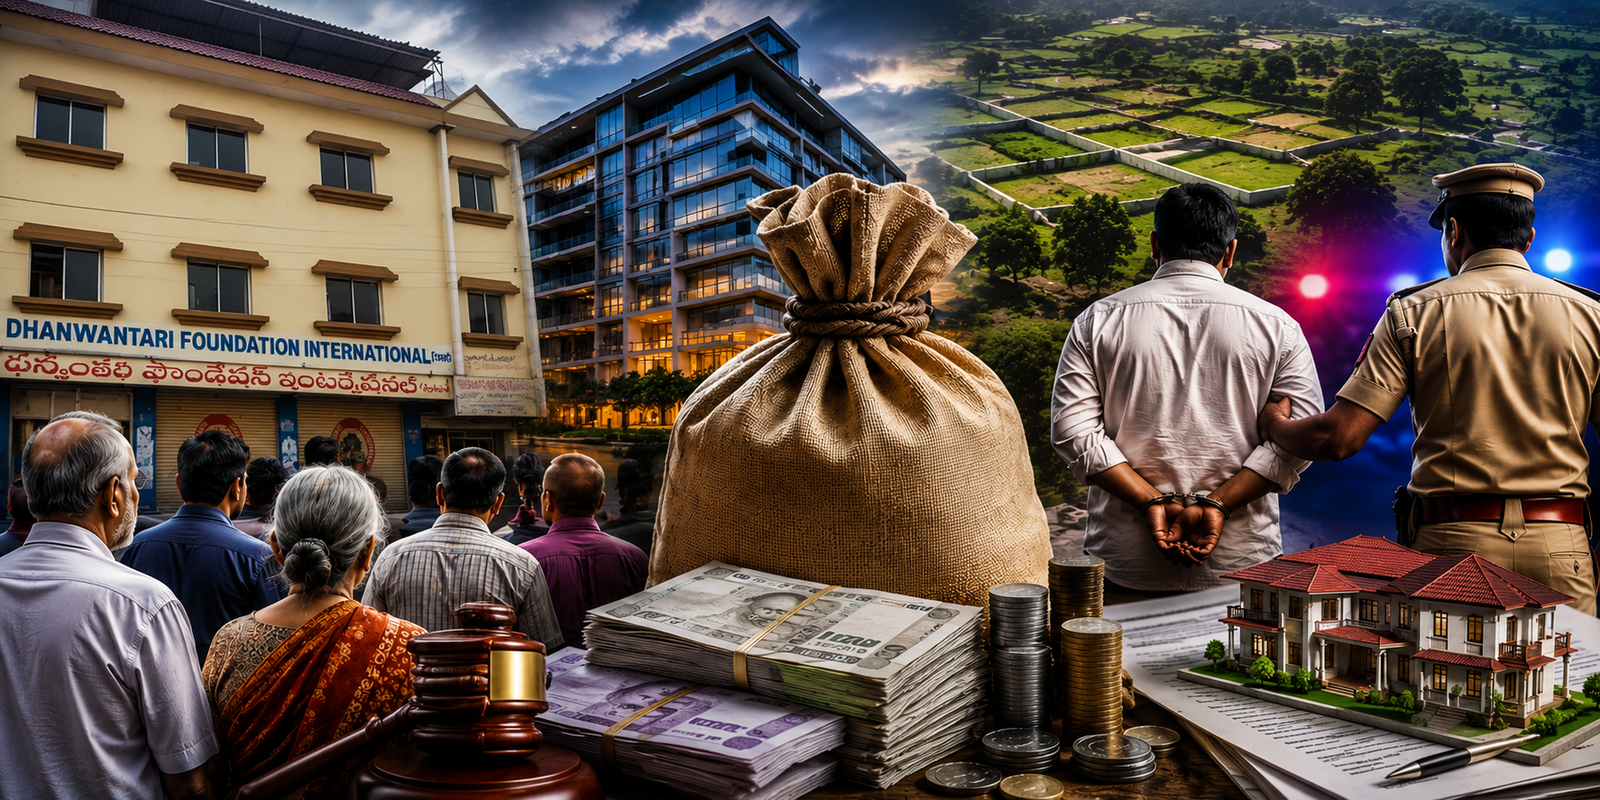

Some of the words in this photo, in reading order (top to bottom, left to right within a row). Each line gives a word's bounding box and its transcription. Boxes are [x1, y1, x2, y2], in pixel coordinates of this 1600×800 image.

[6, 318, 174, 349] DHANWANTARI
[180, 331, 300, 357] FOUNDATION
[304, 339, 431, 365] INTERNATIONAL
